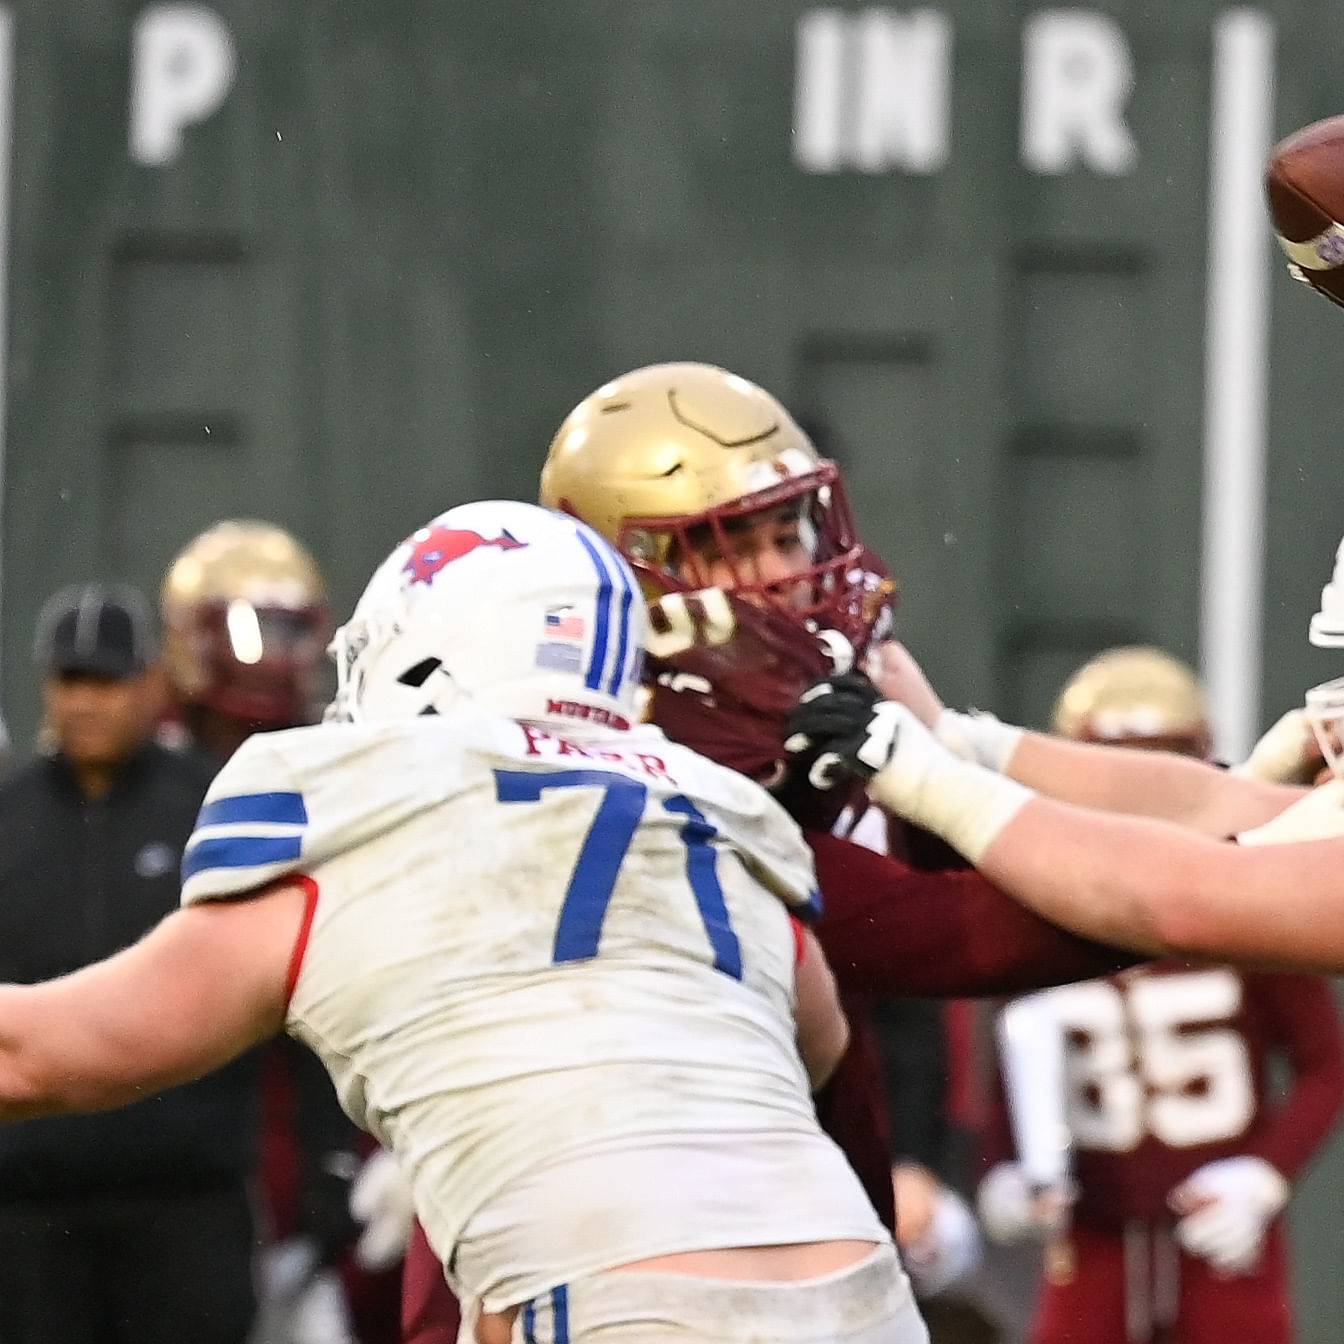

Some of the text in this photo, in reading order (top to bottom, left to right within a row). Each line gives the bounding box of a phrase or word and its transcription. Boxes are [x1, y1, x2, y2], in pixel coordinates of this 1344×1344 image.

[131, 6, 1138, 175] P IN R
[493, 768, 743, 982] 71
